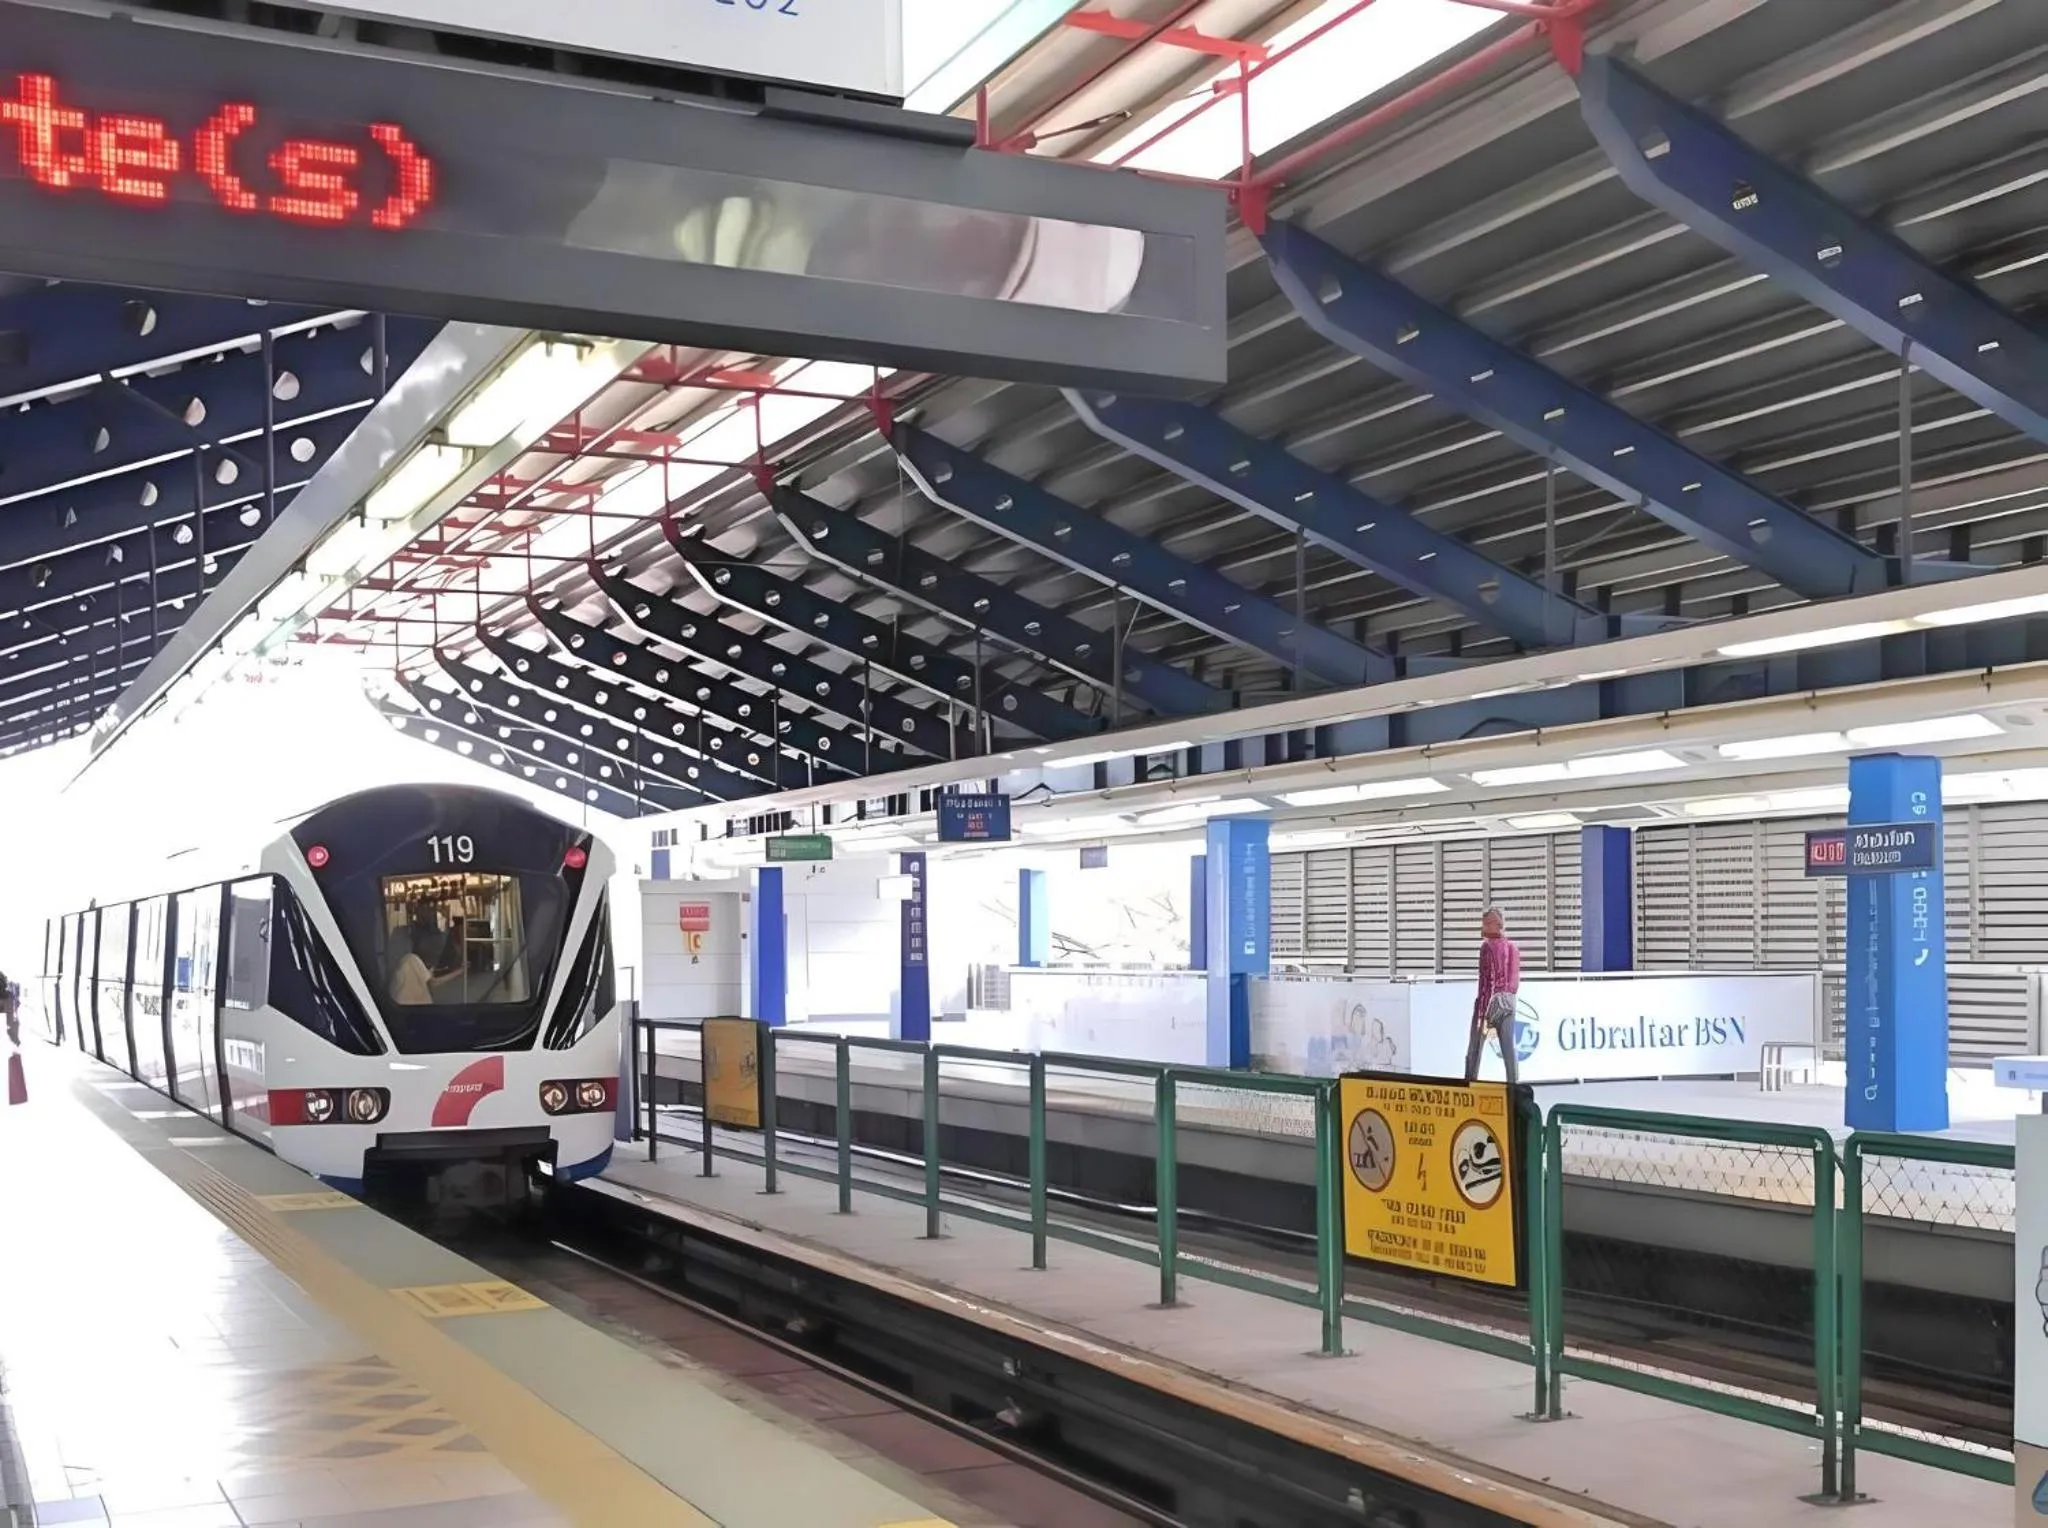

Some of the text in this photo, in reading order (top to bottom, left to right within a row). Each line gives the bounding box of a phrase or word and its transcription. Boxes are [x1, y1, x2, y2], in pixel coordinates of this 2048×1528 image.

[427, 835, 473, 863] 119
[1558, 1015, 1746, 1051] Gibraltar BSN
